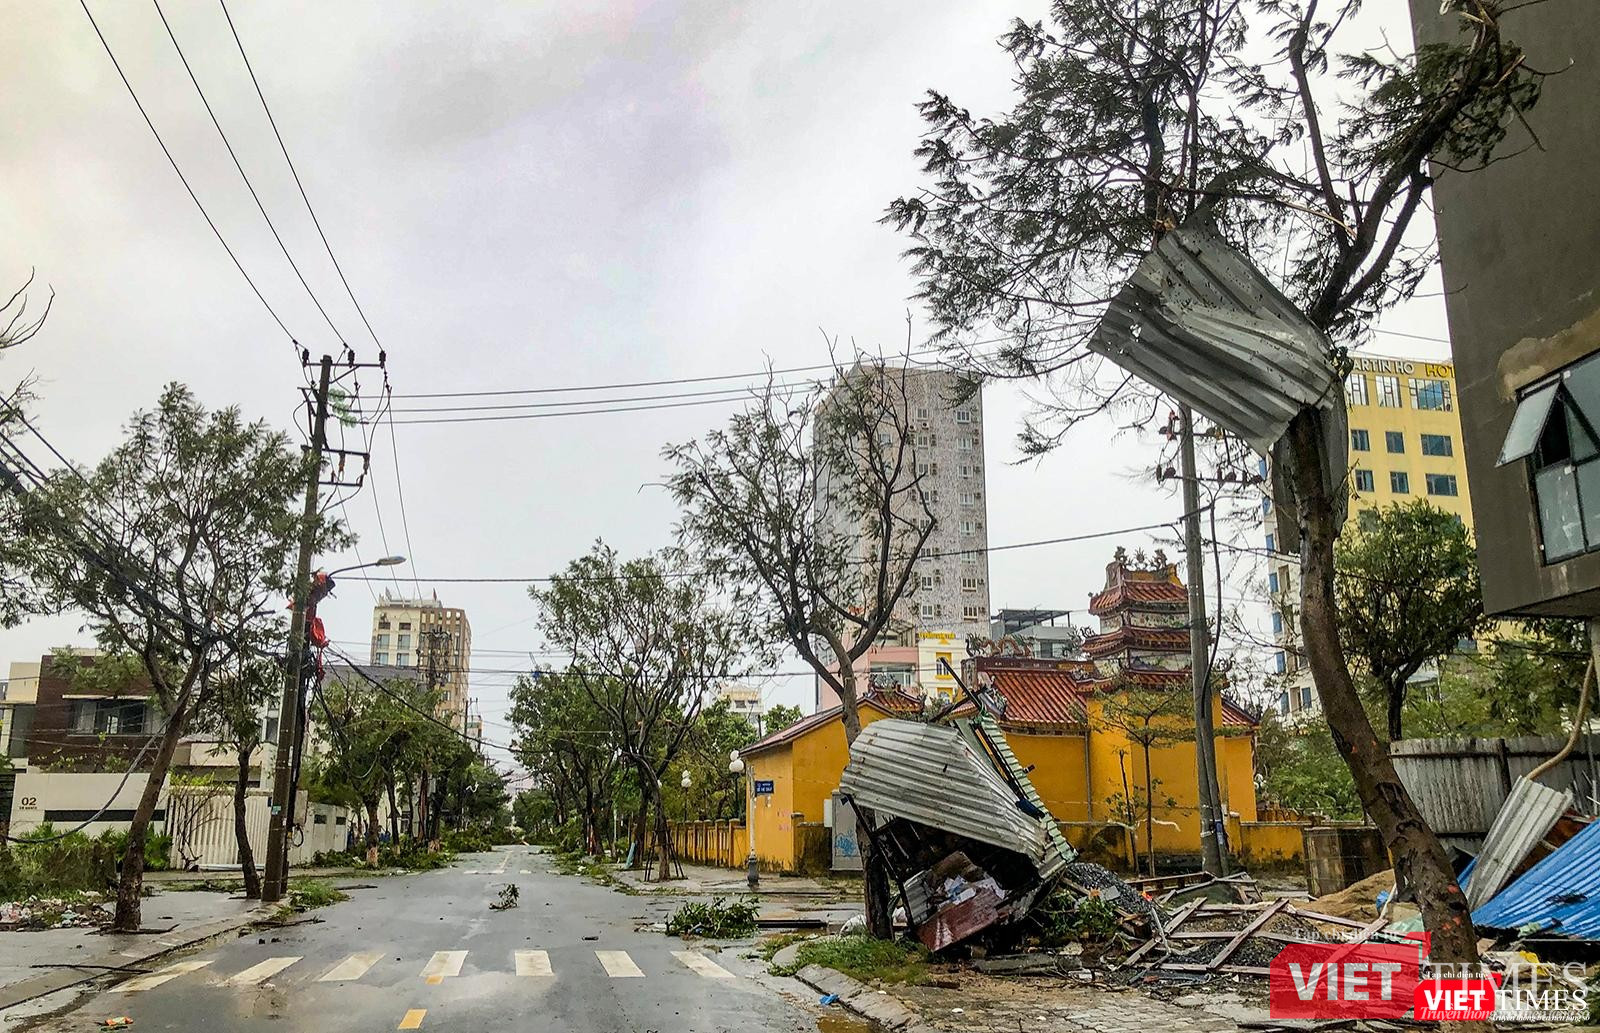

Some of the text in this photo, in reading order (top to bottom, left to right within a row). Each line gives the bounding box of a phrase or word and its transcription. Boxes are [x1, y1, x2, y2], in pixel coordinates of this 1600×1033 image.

[1353, 358, 1391, 374] ARTIN
[1425, 363, 1455, 378] HOT
[21, 797, 37, 806] 02
